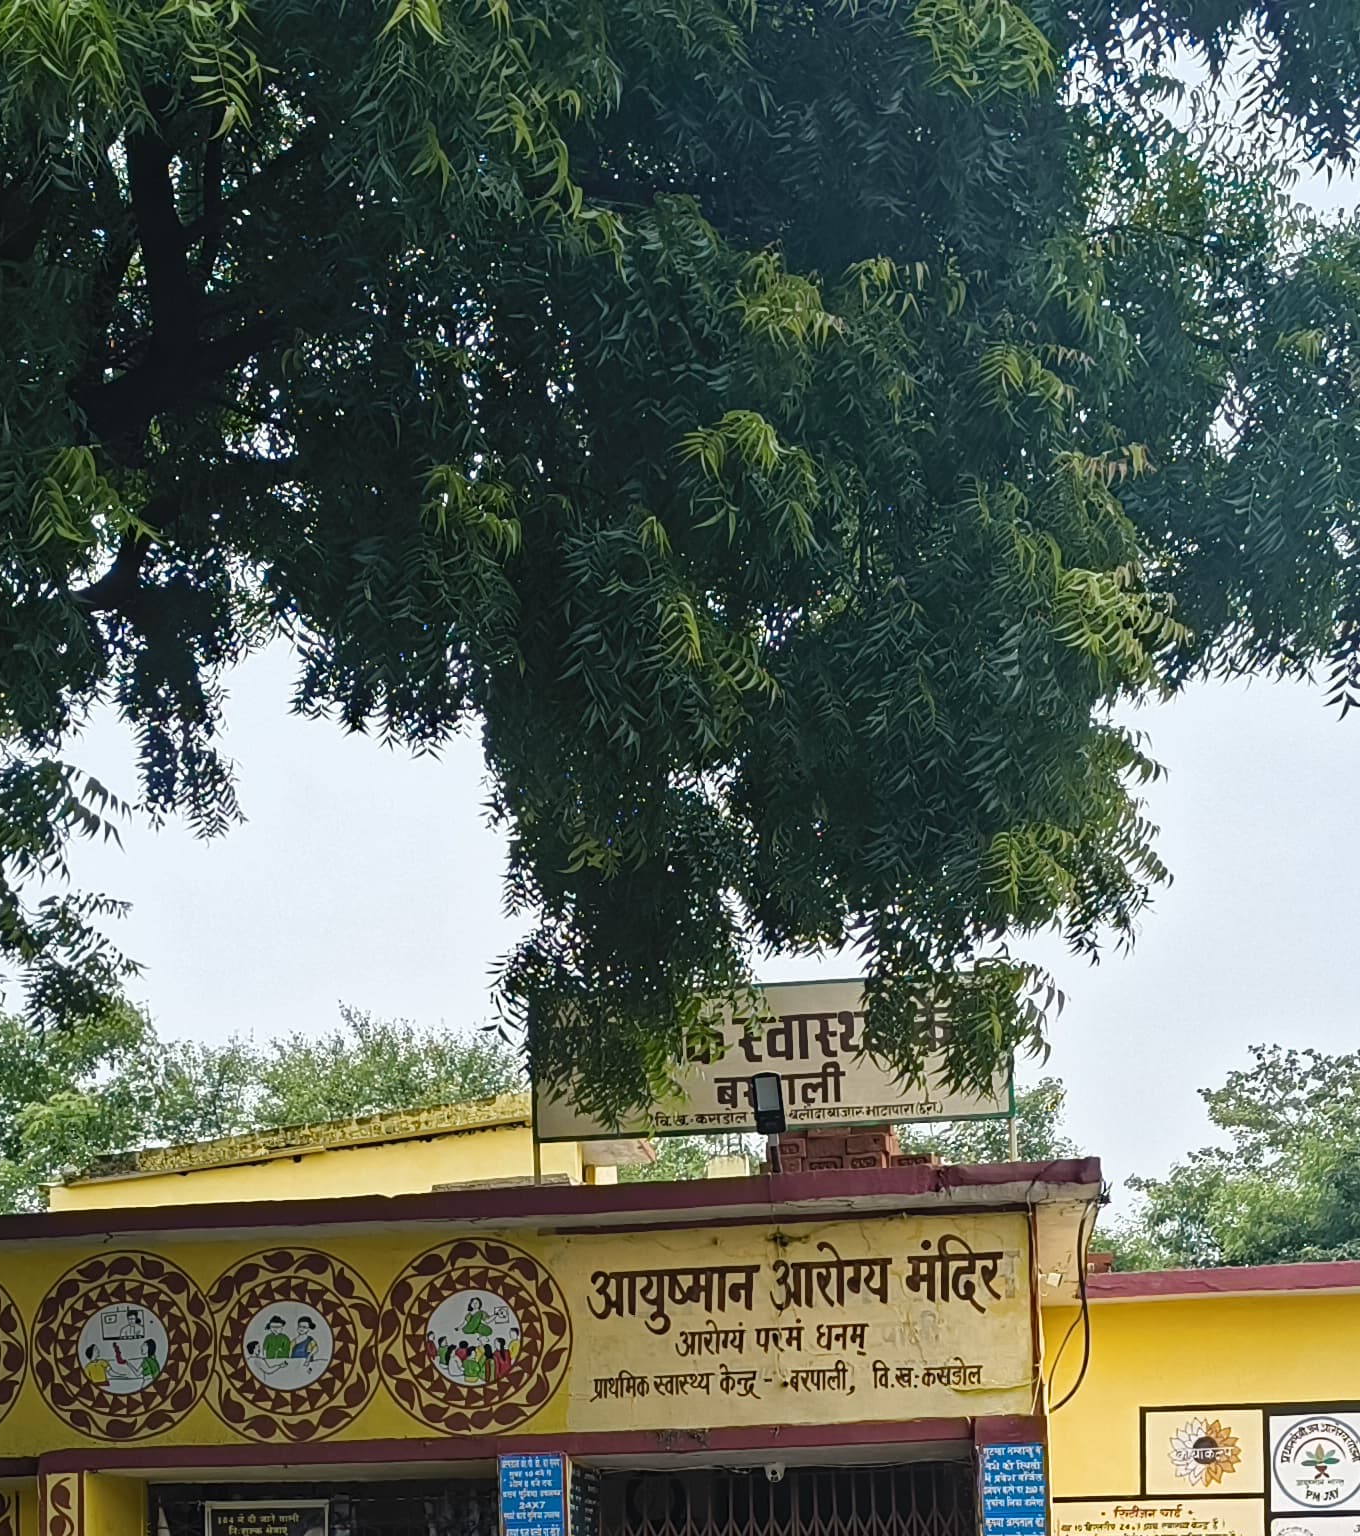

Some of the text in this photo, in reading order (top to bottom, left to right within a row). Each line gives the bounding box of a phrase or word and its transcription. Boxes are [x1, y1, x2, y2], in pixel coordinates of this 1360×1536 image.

[588, 1234, 1003, 1334] आयुष्मान आरोग्य मंदिर
[675, 1319, 744, 1357] आरोग्यं
[756, 1318, 804, 1353] परमं
[817, 1323, 869, 1356] धनम्
[590, 1371, 649, 1402] प्राथमिक
[654, 1371, 714, 1396] स्वास्थ्य
[720, 1364, 761, 1399] केन्द्र
[1176, 1447, 1232, 1459] कायाकल्प
[1306, 1488, 1339, 1501] PM JAY
